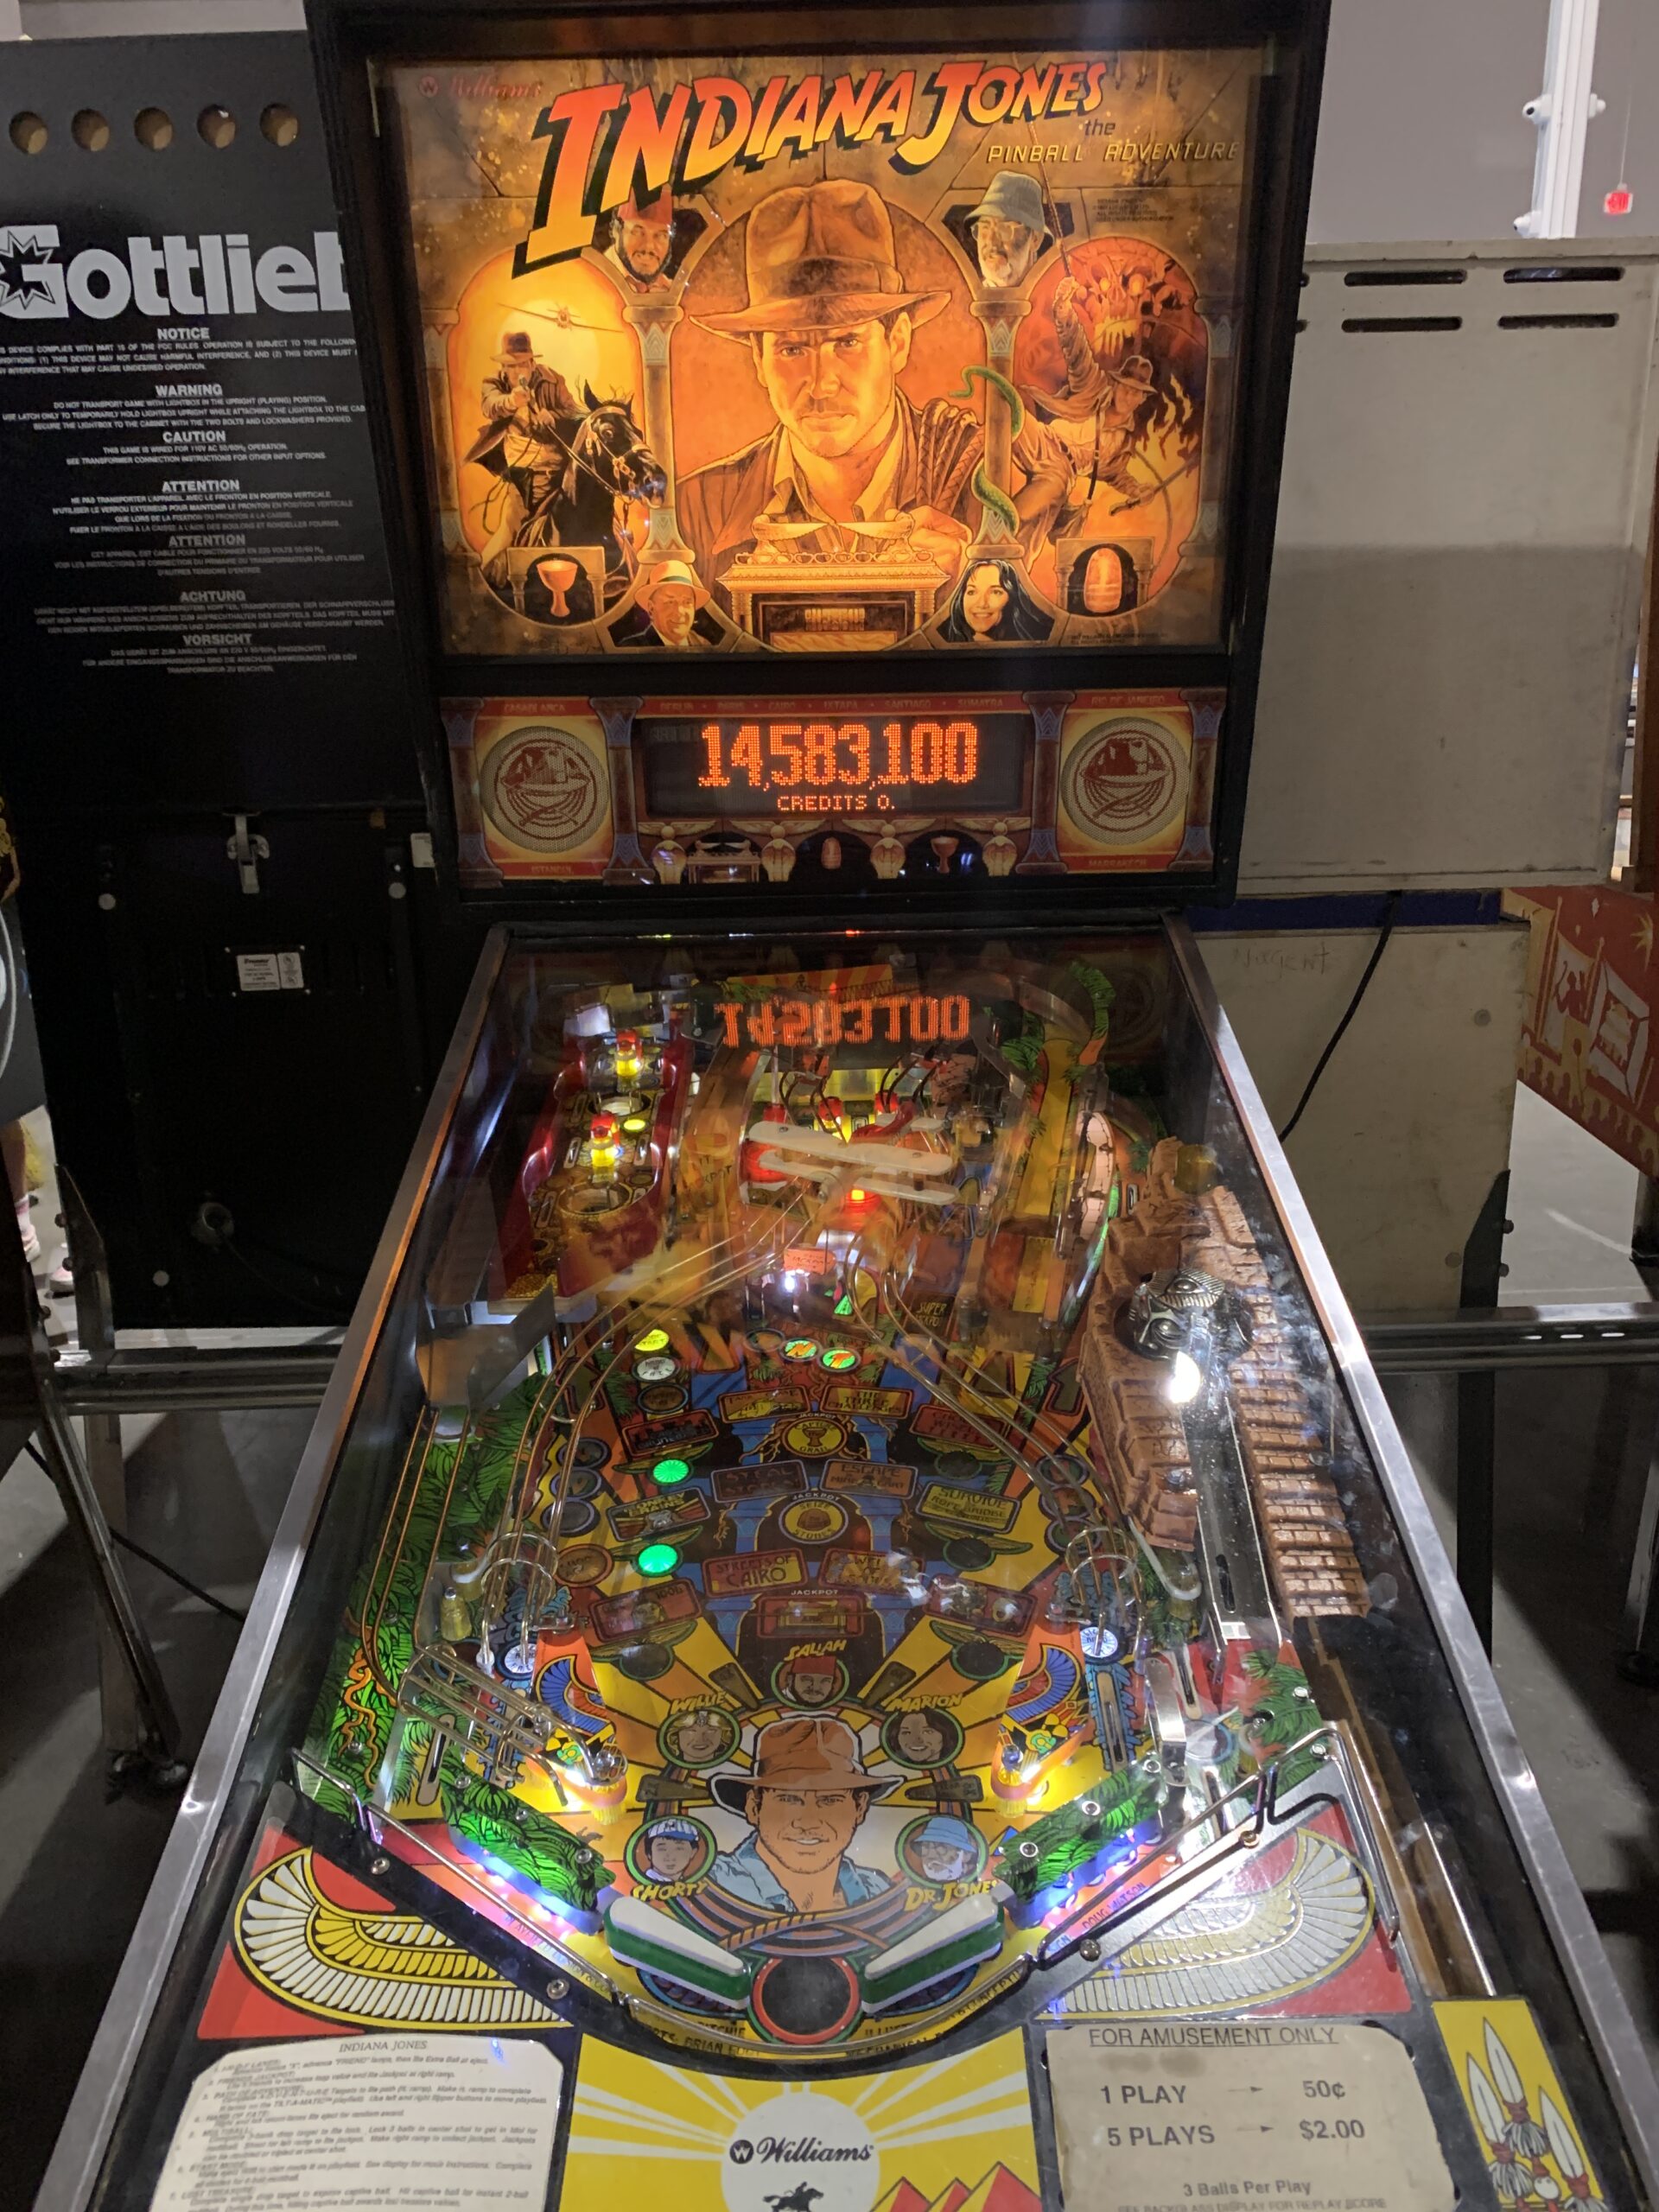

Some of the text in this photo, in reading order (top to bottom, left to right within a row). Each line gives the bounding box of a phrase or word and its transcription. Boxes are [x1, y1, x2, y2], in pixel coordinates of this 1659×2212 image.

[1084, 119, 1116, 136] the
[986, 141, 1241, 163] PINBALL ADVENTURE
[518, 60, 1107, 270] INDIANA JONES
[157, 327, 210, 340] NOTICE
[156, 384, 223, 397] WARNING
[54, 401, 64, 410] DO
[66, 401, 78, 410] NOT
[124, 399, 143, 408] GAME
[166, 398, 199, 407] LIGHTBOX
[211, 397, 222, 406] THE
[226, 397, 254, 405] UPRIGHT
[18, 412, 40, 421] LATCH
[61, 411, 70, 420] TO
[120, 410, 139, 418] HOLD
[142, 409, 175, 417] LIGHTBOX
[178, 408, 207, 416] UPRIGHT
[209, 408, 230, 416] WHILE
[273, 406, 285, 415] THE
[288, 405, 321, 414] LIGHTBOX
[335, 404, 348, 413] THE
[351, 404, 365, 413] CAB
[33, 422, 60, 430] SECURE
[77, 421, 112, 429] LIGHTBOX
[124, 420, 138, 429] THE
[139, 419, 168, 428] CABINET
[170, 419, 188, 428] WITH
[205, 418, 220, 427] TWO
[222, 417, 244, 426] BOLTS
[245, 417, 260, 426] AND
[162, 430, 226, 442] CAUTION
[162, 480, 240, 493] ATTENTION
[168, 534, 246, 547] ATTENTION
[181, 590, 246, 602] ACHTUNG
[182, 633, 252, 646] VORSICHT
[885, 700, 931, 709] SANTIAGO
[957, 698, 1003, 709] SUMATRA
[698, 722, 977, 791] 14,583,100
[777, 795, 868, 811] CREDITS
[916, 1302, 947, 1315] SUPER
[787, 1342, 814, 1356] N
[830, 1352, 855, 1369] T
[841, 1464, 900, 1477] ESCAPE
[792, 1492, 841, 1501] JACKPOT
[931, 1495, 959, 1509] ROPE
[939, 1487, 1008, 1510] SURVIVE
[716, 1555, 791, 1573] STREETS OF
[727, 1568, 786, 1586] CAIRO
[784, 1639, 848, 1661] SALLAH
[670, 1691, 727, 1713] WILLIE
[885, 1694, 963, 1713] MARION
[630, 1879, 709, 1901] SHORTY
[933, 1879, 996, 1911] JONE
[1083, 1909, 1109, 1929] DOUG
[1090, 2026, 1335, 2045] FOR AMUSEMENT ONLY
[339, 2040, 428, 2052] INDIANA JONES
[684, 2037, 723, 2054] BRIAN
[1101, 2080, 1345, 2104] 1 PLAY 50¢
[1108, 2120, 1365, 2146] 5 PLAYS $2.00
[756, 2137, 872, 2164] Williams
[1183, 2180, 1312, 2196] 3 Balls Per Play
[1217, 2202, 1265, 2211] DISPLAY
[1268, 2201, 1294, 2210] FOR
[1294, 2200, 1341, 2209] REPLAY
[1344, 2198, 1387, 2209] SCORE
